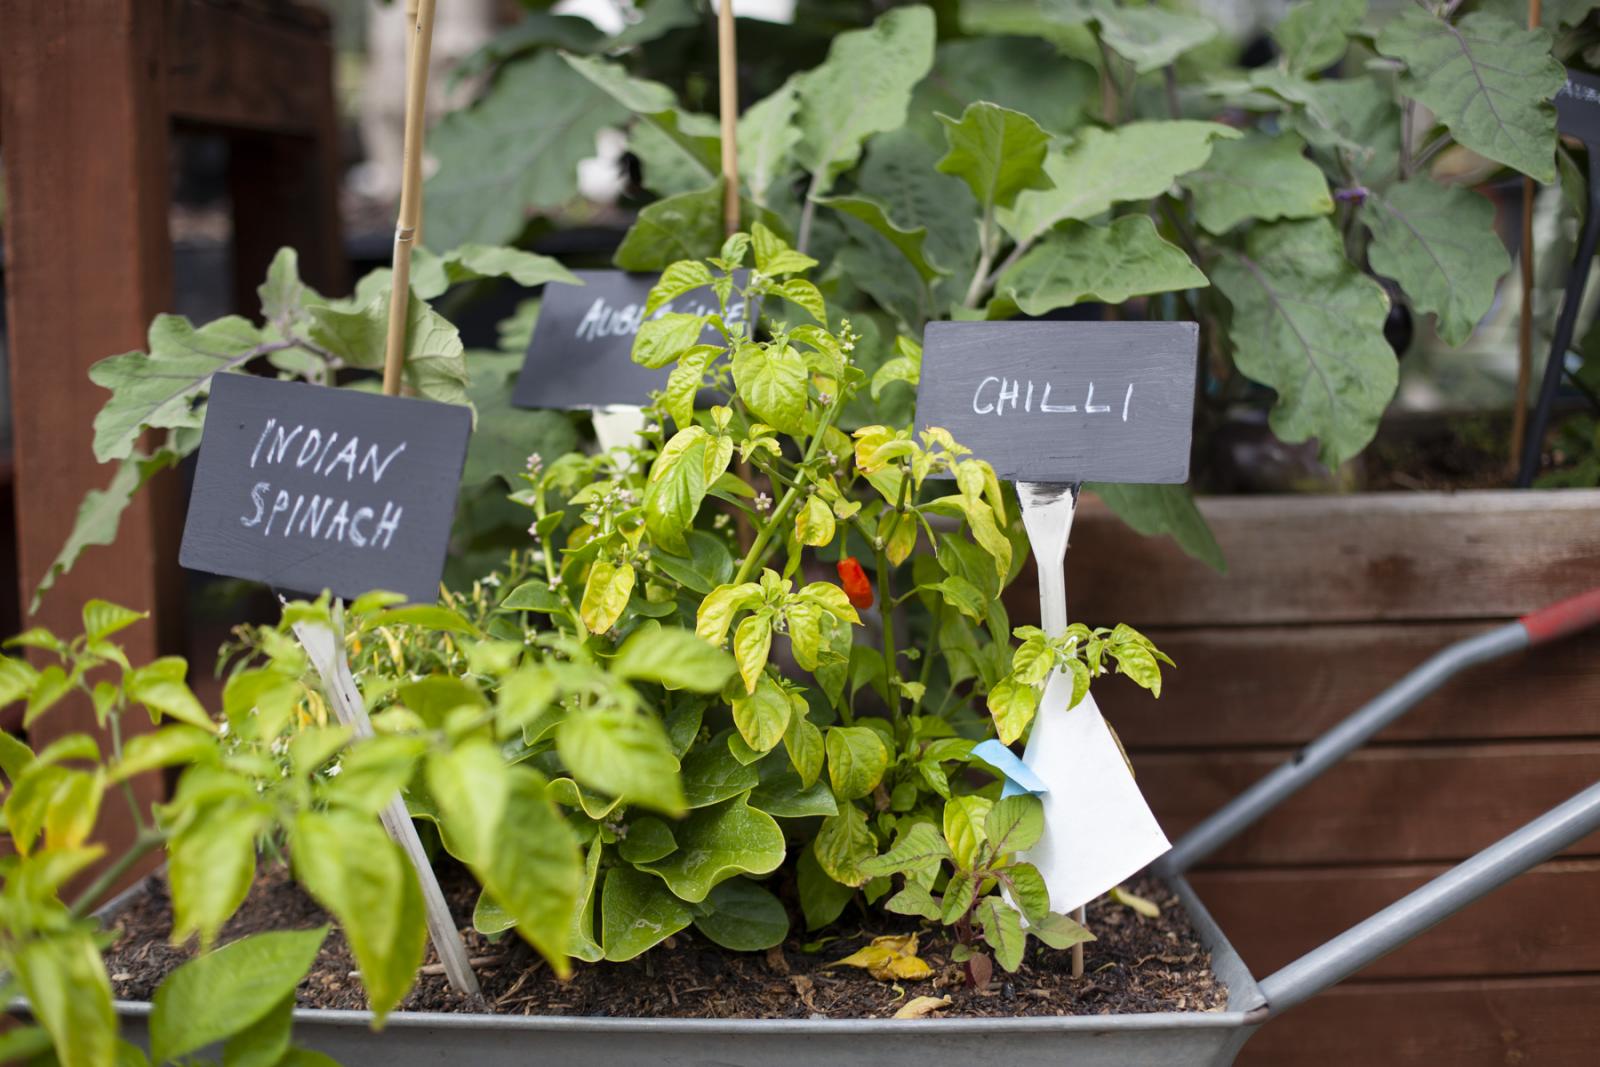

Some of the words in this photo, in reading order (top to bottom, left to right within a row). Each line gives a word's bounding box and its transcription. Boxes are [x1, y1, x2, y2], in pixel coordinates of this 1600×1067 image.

[973, 376, 1133, 422] CHILLI
[251, 418, 406, 483] INDIAN
[240, 481, 403, 549] SPINACH
